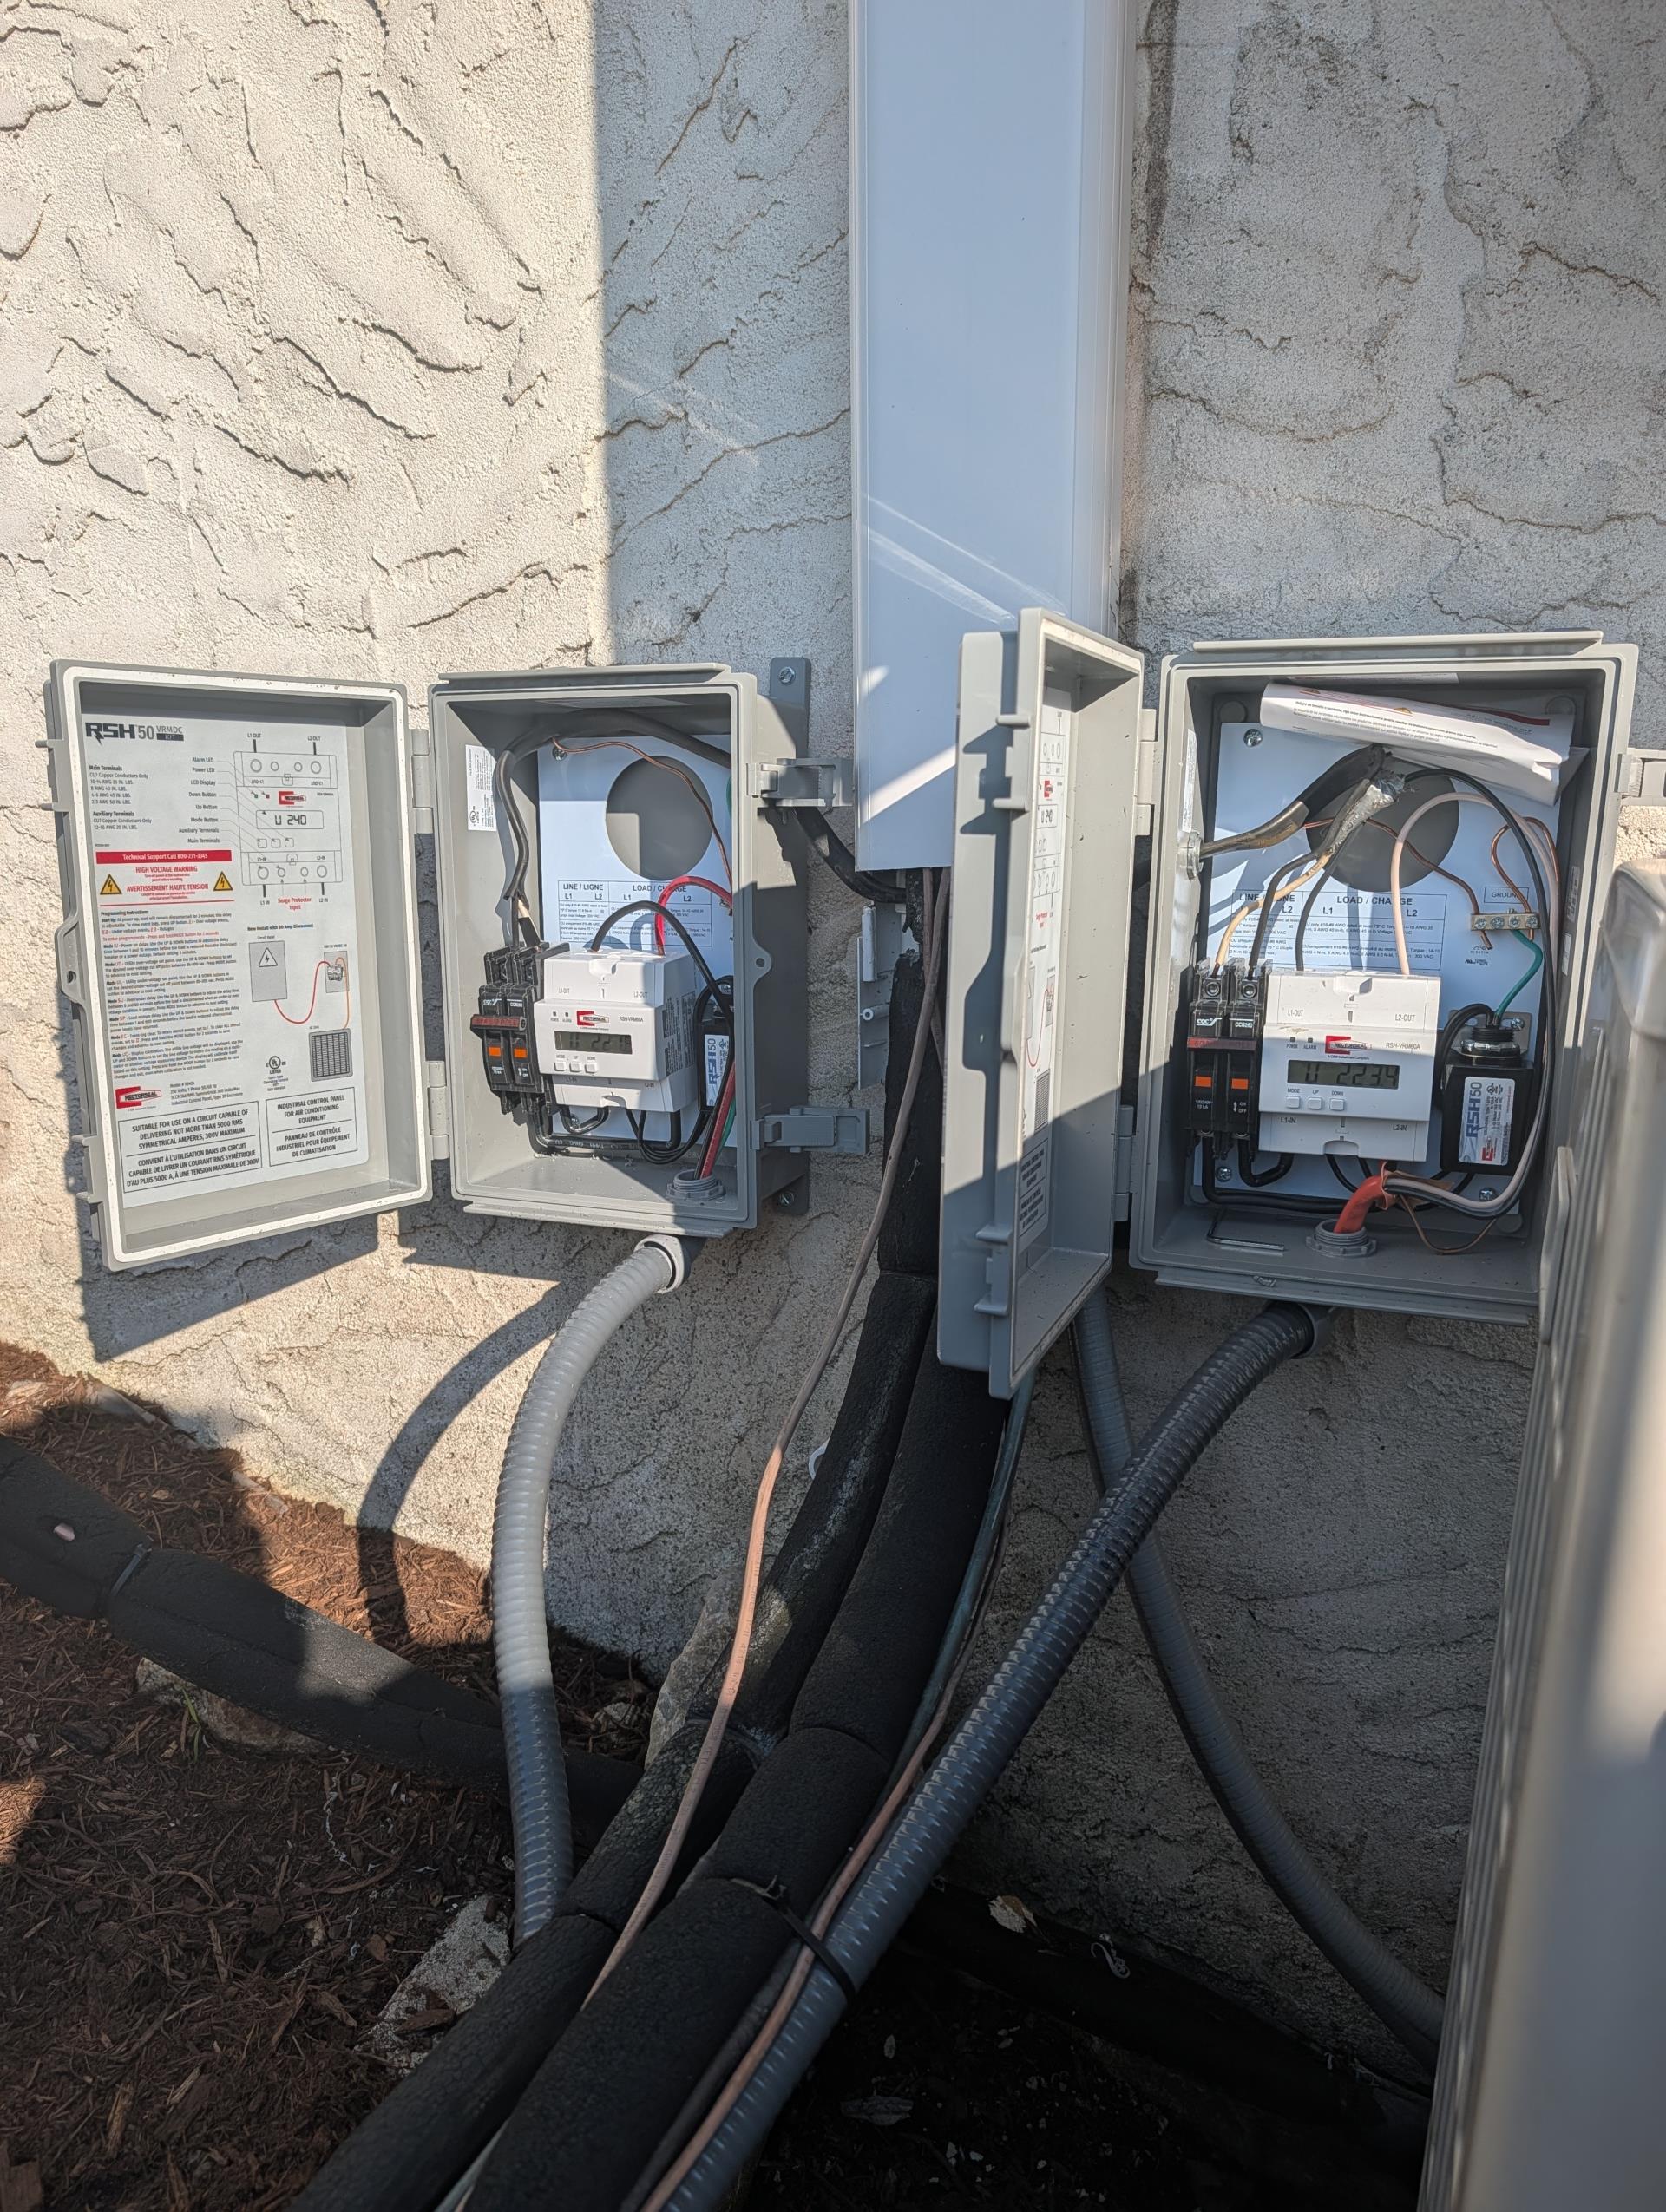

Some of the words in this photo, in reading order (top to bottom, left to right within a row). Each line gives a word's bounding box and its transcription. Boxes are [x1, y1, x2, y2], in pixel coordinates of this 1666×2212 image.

[85, 723, 135, 740] RSH
[138, 726, 154, 739] 50
[288, 815, 306, 825] 240
[1337, 896, 1363, 905] LOAD
[1372, 897, 1413, 906] CHAGE
[708, 1038, 716, 1050] 50
[708, 1051, 717, 1084] RSH
[1471, 1082, 1482, 1096] 50
[278, 1102, 305, 1110] INDUSTRIAL
[305, 1104, 339, 1114] CONDITIONING
[132, 1123, 157, 1132] SUITABLE
[197, 1114, 217, 1122] CIRCUIT
[219, 1110, 239, 1119] CAPABLE
[298, 1115, 326, 1123] EQUIPMENT
[1466, 1098, 1481, 1138] RSH
[139, 1139, 176, 1149] SYMMETRICAL
[178, 1134, 204, 1143] AMPERES,
[220, 1128, 245, 1136] MAXIMUM
[140, 1130, 172, 1140] DELIVERING
[285, 1133, 308, 1142] PANNEAU
[317, 1126, 341, 1136] CONTRÔLE
[277, 1142, 305, 1151] INDUSTRIEL
[300, 1145, 336, 1155] CLIMATISATION
[129, 1168, 152, 1177] CAPABLE
[161, 1163, 179, 1172] LIVRER
[188, 1157, 213, 1167] COURANT
[139, 1156, 163, 1166] CONVIENT
[192, 1167, 212, 1175] TENSION
[213, 1163, 239, 1172] MAXIMALE
